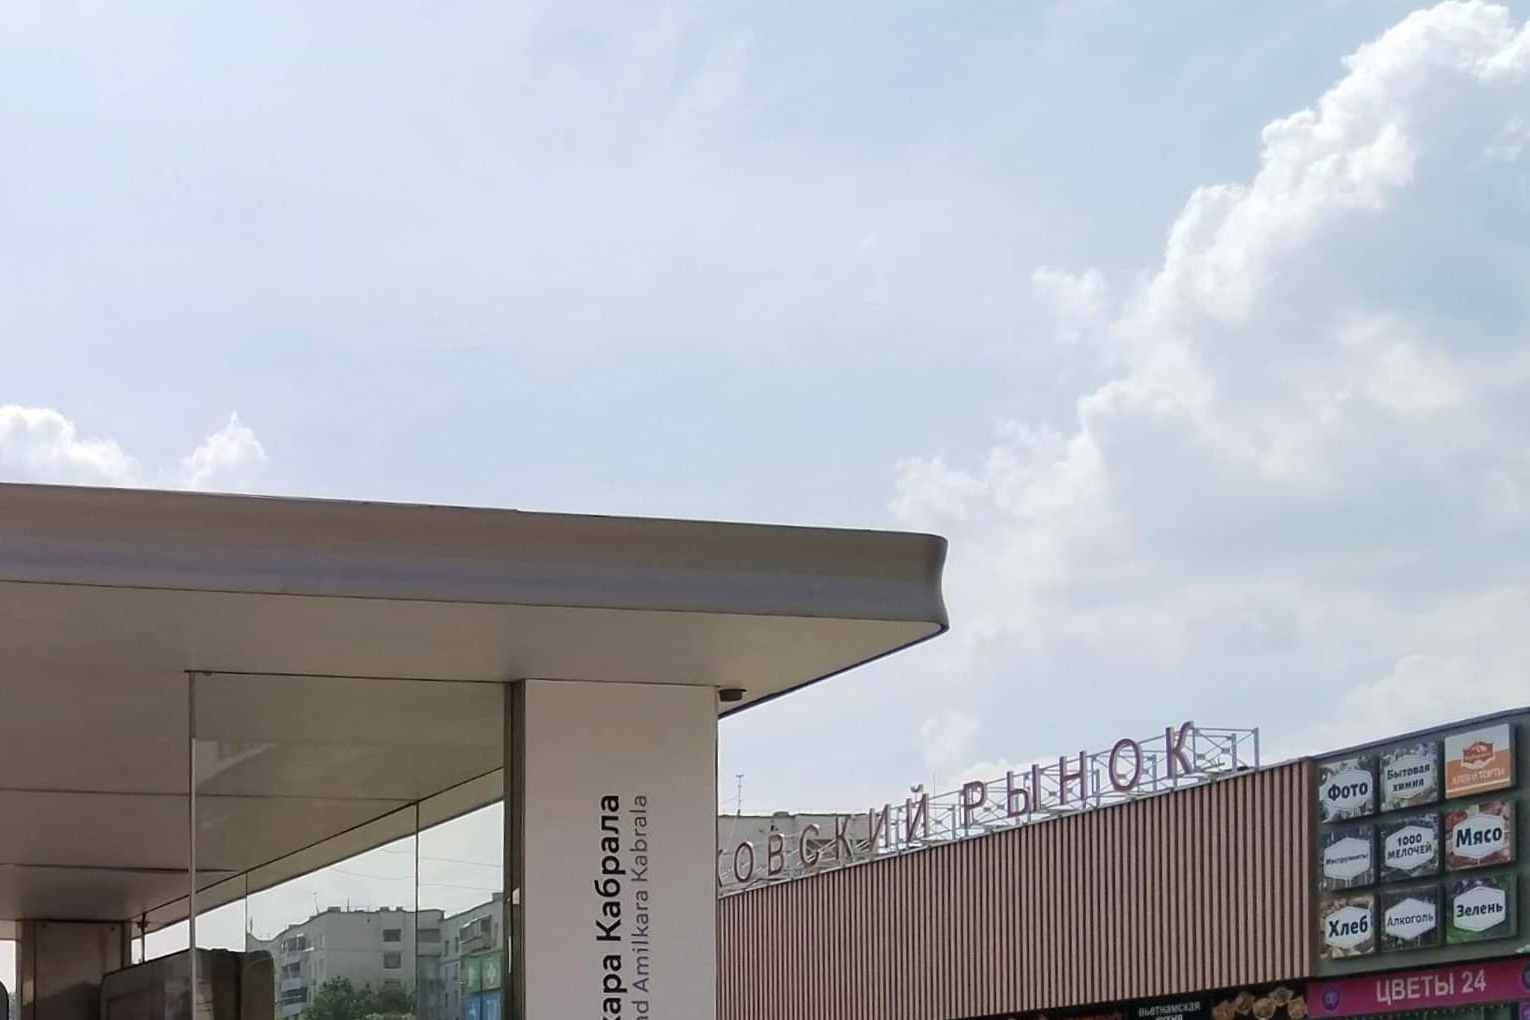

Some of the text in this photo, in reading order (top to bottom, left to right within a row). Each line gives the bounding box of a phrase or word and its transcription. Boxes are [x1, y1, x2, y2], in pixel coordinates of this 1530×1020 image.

[1387, 763, 1430, 780] Бытовая
[1328, 781, 1368, 801] Фото
[1393, 777, 1424, 792] химия
[719, 721, 1193, 887] ОВСКИЙ РЫНОК
[630, 795, 647, 882] Kabrala
[1397, 833, 1422, 847] 1000
[1456, 827, 1502, 848] Мясо
[1387, 843, 1432, 859] МЕЛОЧЕЙ
[595, 795, 626, 942] Кабрала
[1387, 911, 1434, 926] Алкоголь
[1456, 902, 1503, 918] Зелень
[1328, 915, 1368, 938] Хлеб
[631, 890, 649, 993] Amilkara
[1376, 969, 1487, 1005] ЦВЕТЫ 24
